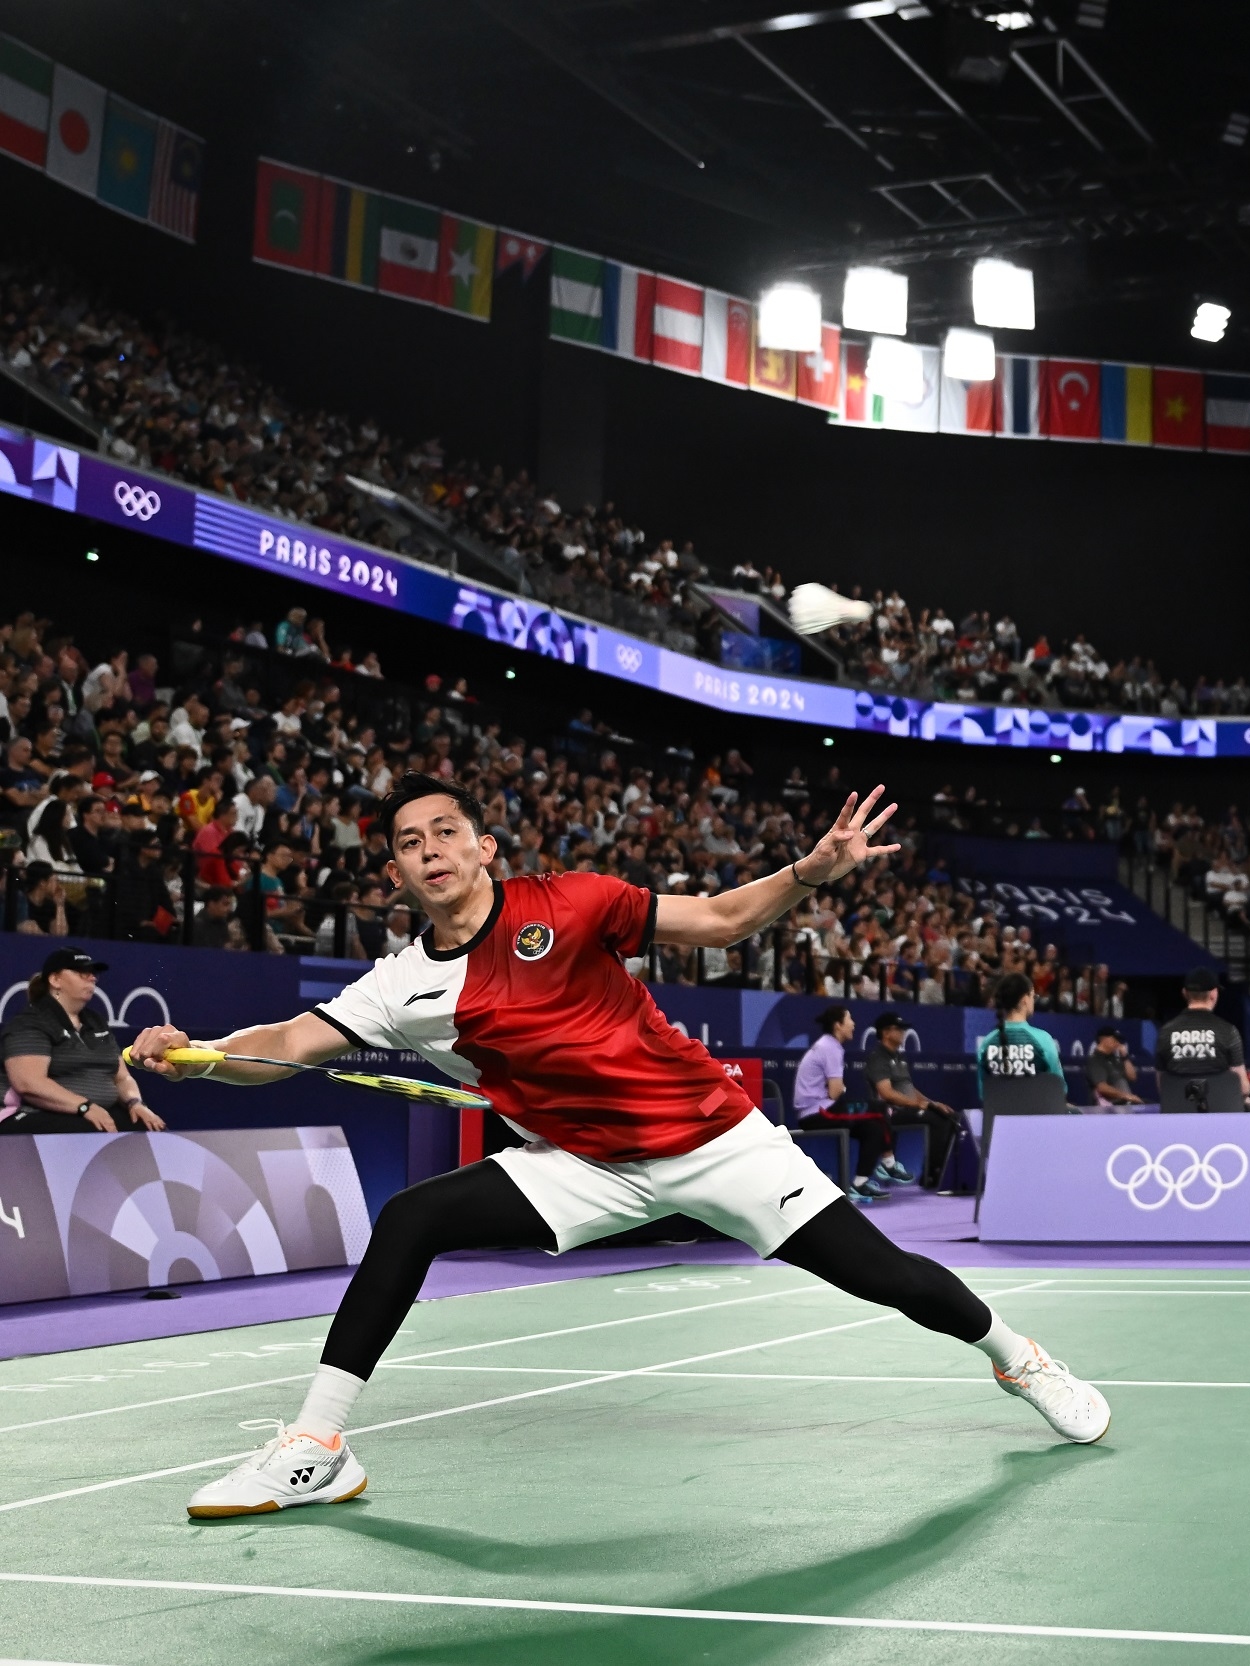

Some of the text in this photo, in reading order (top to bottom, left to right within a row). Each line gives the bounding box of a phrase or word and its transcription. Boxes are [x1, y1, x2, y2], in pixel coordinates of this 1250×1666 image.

[338, 554, 398, 597] 2024
[748, 684, 805, 711] 2024
[980, 900, 1136, 925] 2024
[1172, 1044, 1216, 1059] 2024
[989, 1060, 1036, 1075] 2024
